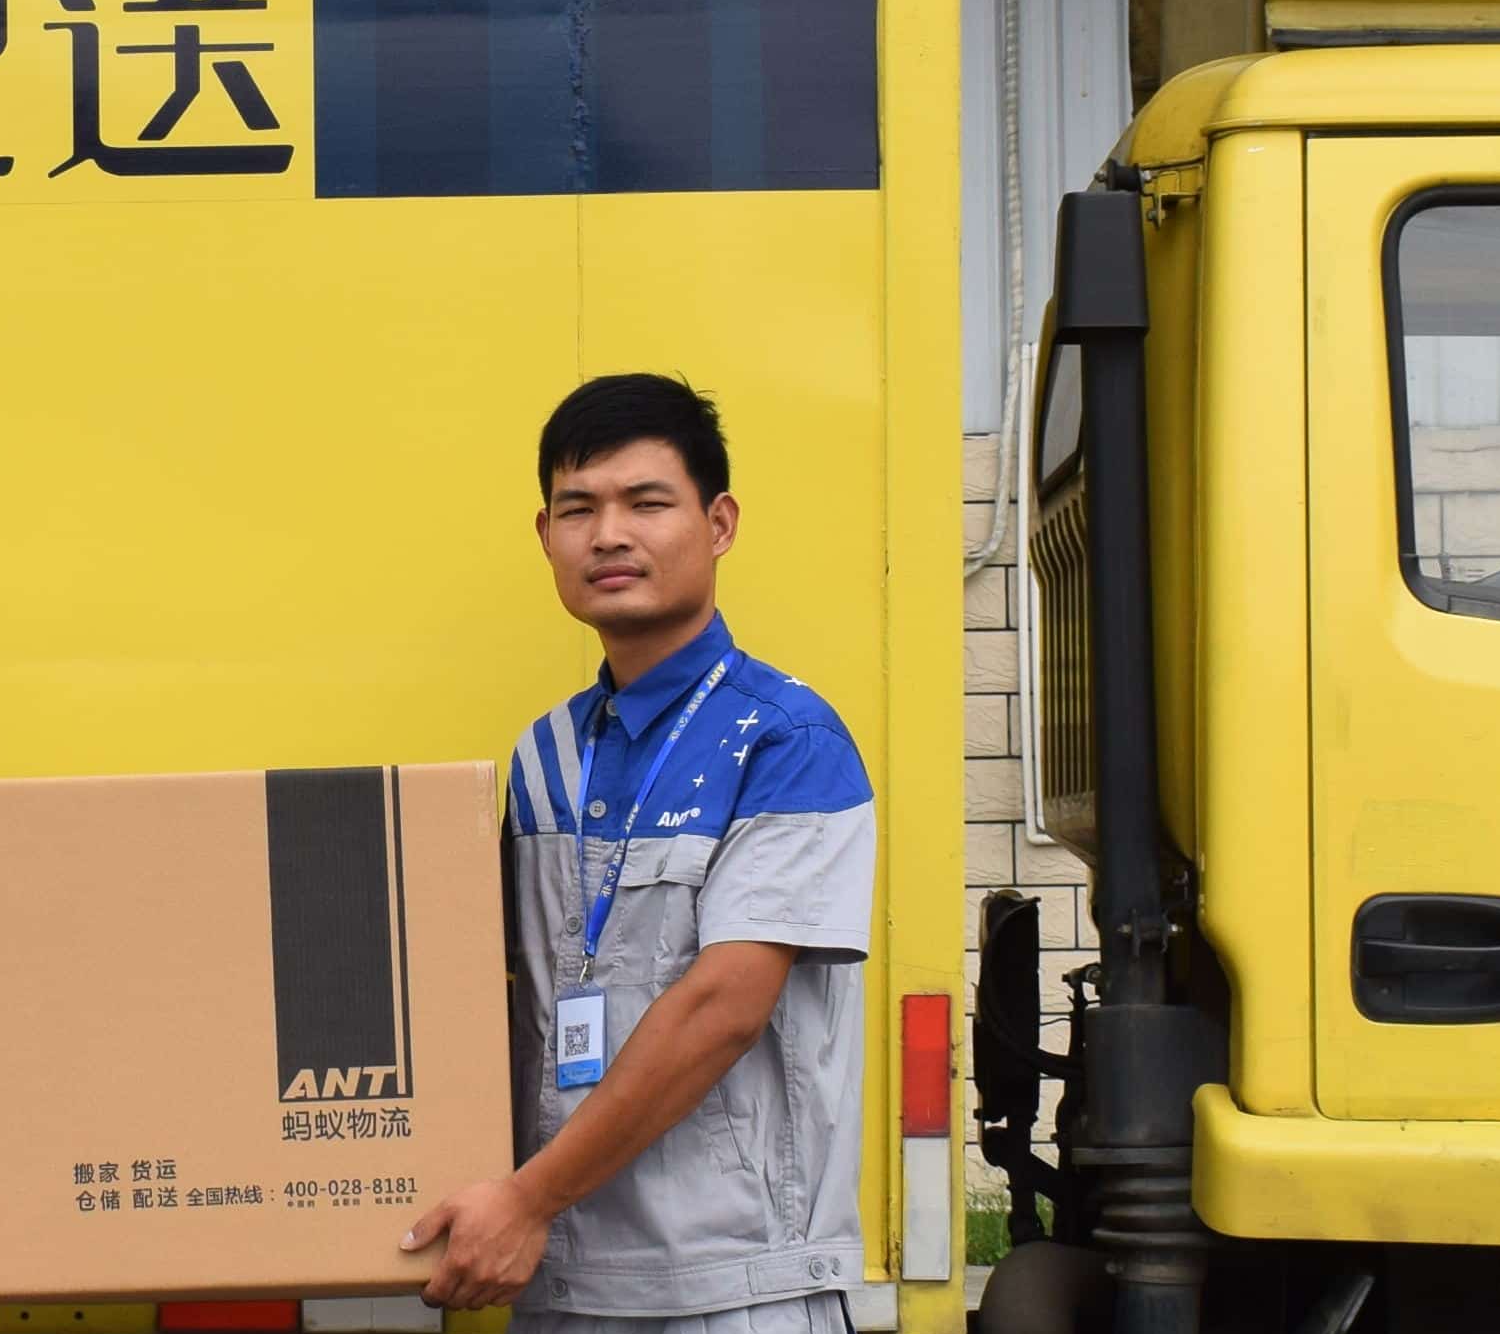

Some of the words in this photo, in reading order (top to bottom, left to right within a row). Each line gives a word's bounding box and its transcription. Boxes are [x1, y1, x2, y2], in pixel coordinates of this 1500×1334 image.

[281, 1066, 397, 1100] ANT
[281, 1107, 412, 1141] 蚂蚁物流
[73, 1161, 120, 1185] 搬家
[131, 1159, 177, 1182] 货运
[75, 1188, 120, 1211] 仓储
[132, 1186, 178, 1208] 配送
[284, 1177, 418, 1197] 400-028-8181
